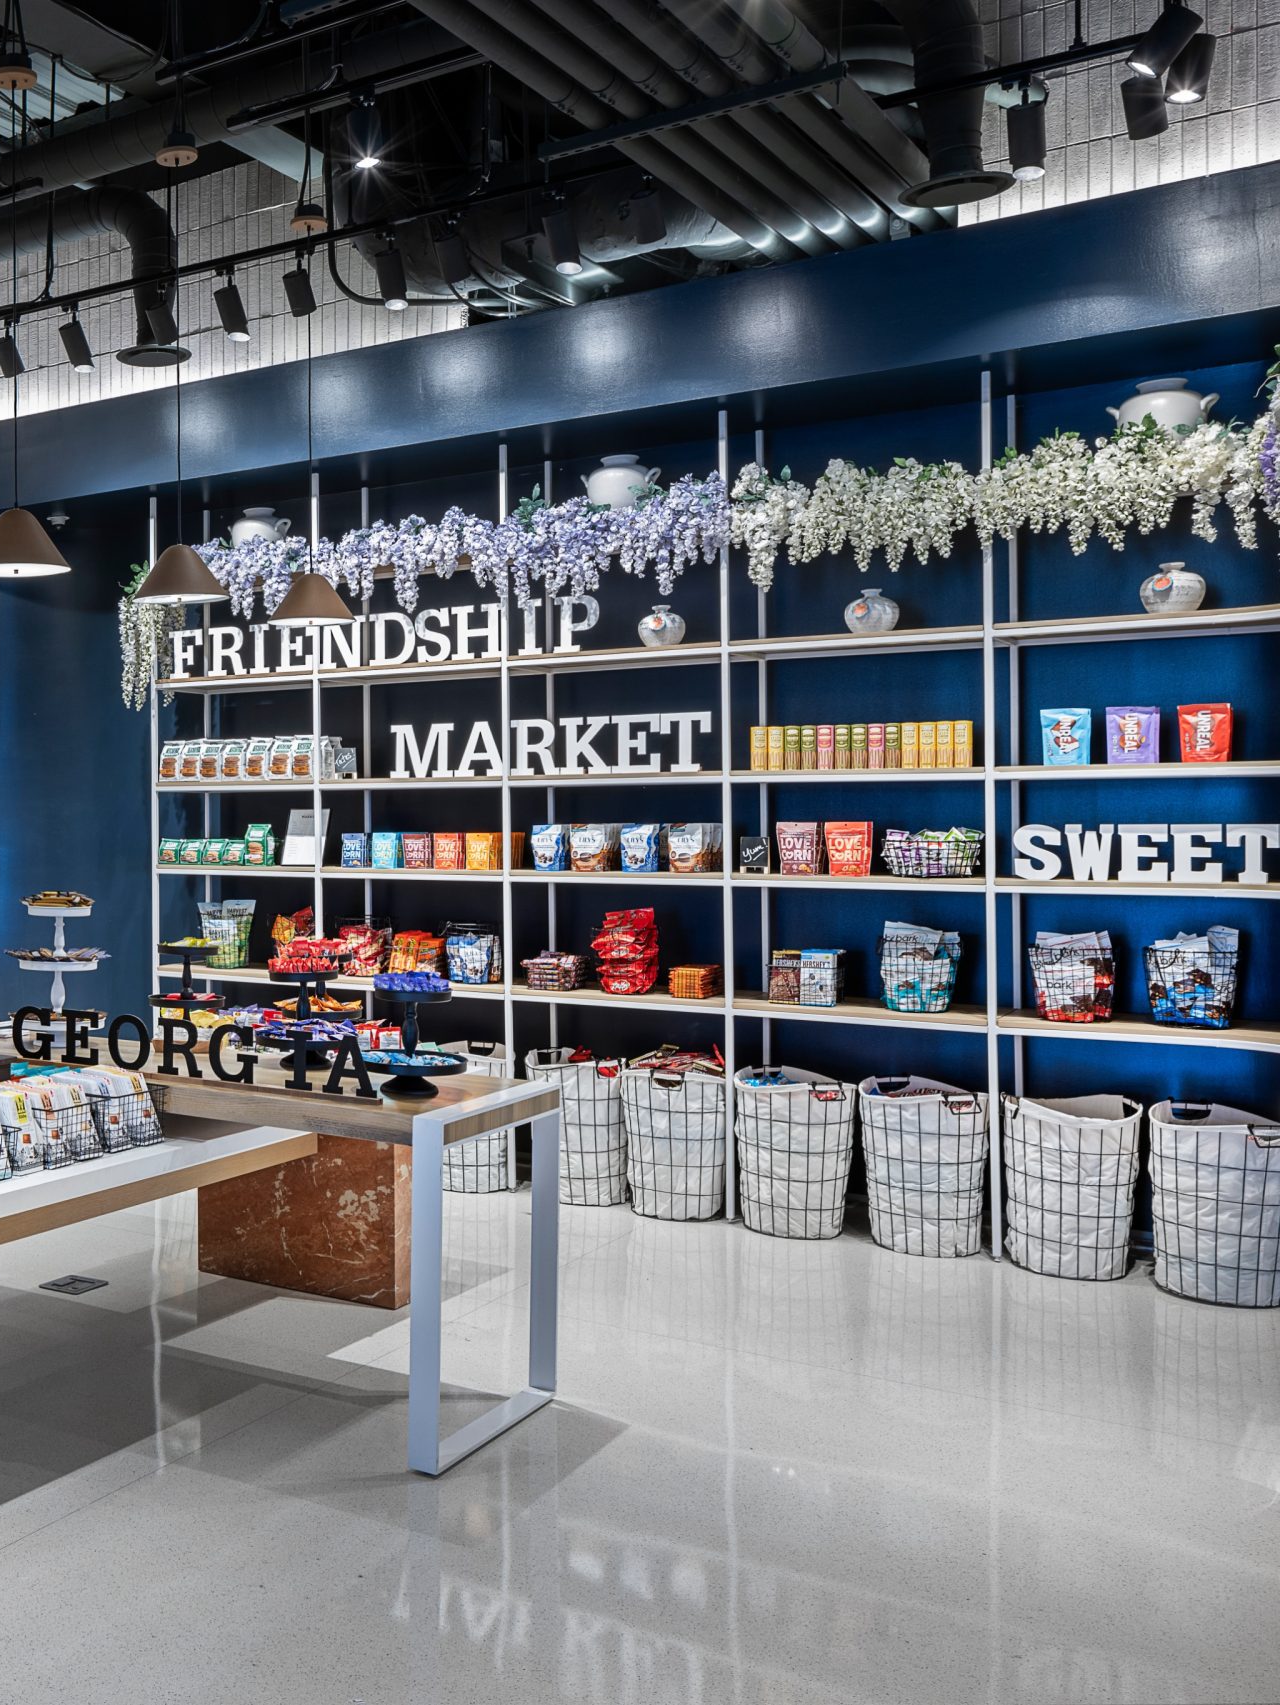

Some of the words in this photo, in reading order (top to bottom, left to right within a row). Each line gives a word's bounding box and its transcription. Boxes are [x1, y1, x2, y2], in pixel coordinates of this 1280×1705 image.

[168, 594, 600, 679] FRIENDSHIP
[1124, 712, 1139, 753] UNREAL
[1196, 709, 1212, 752] UNREAL
[389, 711, 712, 779] MARKET
[343, 843, 361, 851] LOVE
[373, 843, 392, 851] LOVE
[405, 843, 424, 851] LOVE
[436, 843, 455, 851] LOVE
[468, 843, 488, 851] LOVE
[780, 838, 812, 849] LOVE
[828, 838, 862, 850] LOVE
[343, 850, 361, 859] CORN
[373, 850, 392, 859] CORN
[405, 850, 424, 859] CORN
[436, 850, 455, 859] CORN
[468, 850, 488, 859] CORN
[781, 849, 812, 861] CORN
[829, 849, 862, 861] CORN
[1013, 824, 1280, 884] SWEET
[896, 934, 919, 943] bark
[1046, 980, 1073, 989] bark
[12, 1006, 378, 1098] GEORGIA
